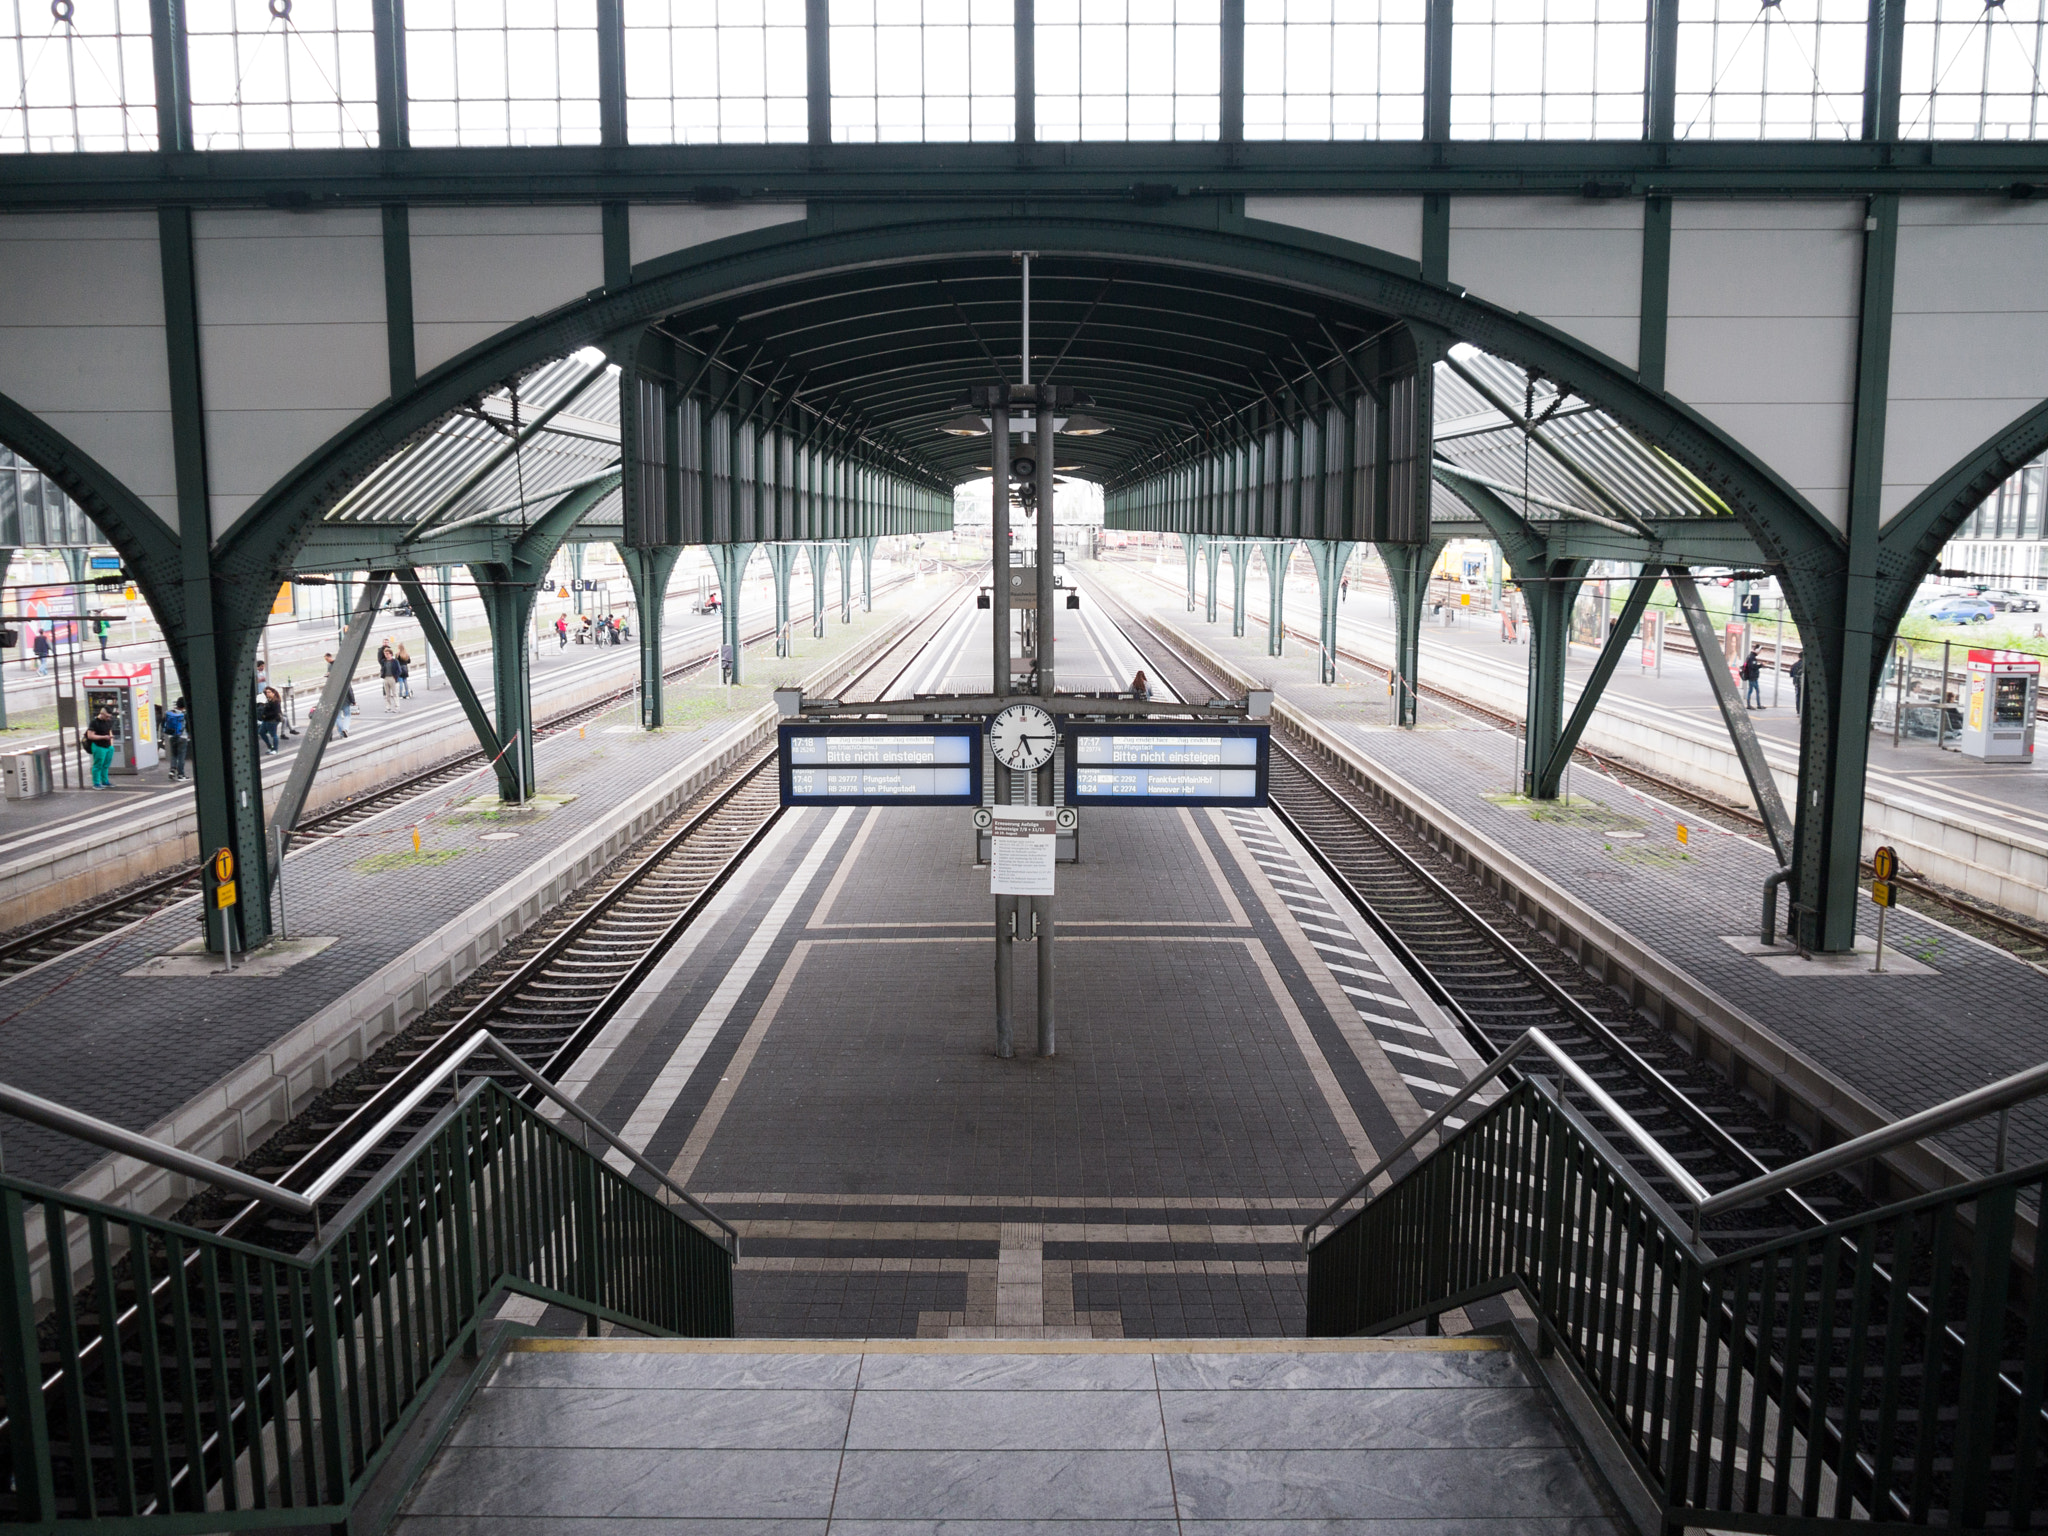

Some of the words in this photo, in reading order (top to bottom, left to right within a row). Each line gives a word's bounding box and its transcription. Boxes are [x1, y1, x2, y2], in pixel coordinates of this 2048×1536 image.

[543, 580, 552, 590] 8
[588, 580, 596, 590] 7
[1054, 576, 1062, 586] 5
[1742, 595, 1753, 609] 4
[793, 737, 814, 747] 17:18
[1079, 737, 1100, 746] 17:17
[827, 751, 851, 762] Bitte
[854, 751, 879, 762] nicht
[883, 751, 934, 763] einsteigen
[1113, 751, 1137, 762] Bitte
[1140, 751, 1165, 762] nicht
[1169, 752, 1220, 764] einsteigen
[793, 775, 813, 783] 17:40
[828, 775, 837, 783] RB
[863, 775, 901, 784] Pfungstadt
[1078, 775, 1097, 783] 17:24
[793, 785, 813, 793] 18:17
[828, 785, 837, 793] RB
[878, 785, 916, 794] Pfungstadt
[1078, 784, 1097, 793] 18:24
[1112, 785, 1119, 793] IC
[1148, 785, 1180, 794] Hannover
[1182, 785, 1195, 794] Hbf
